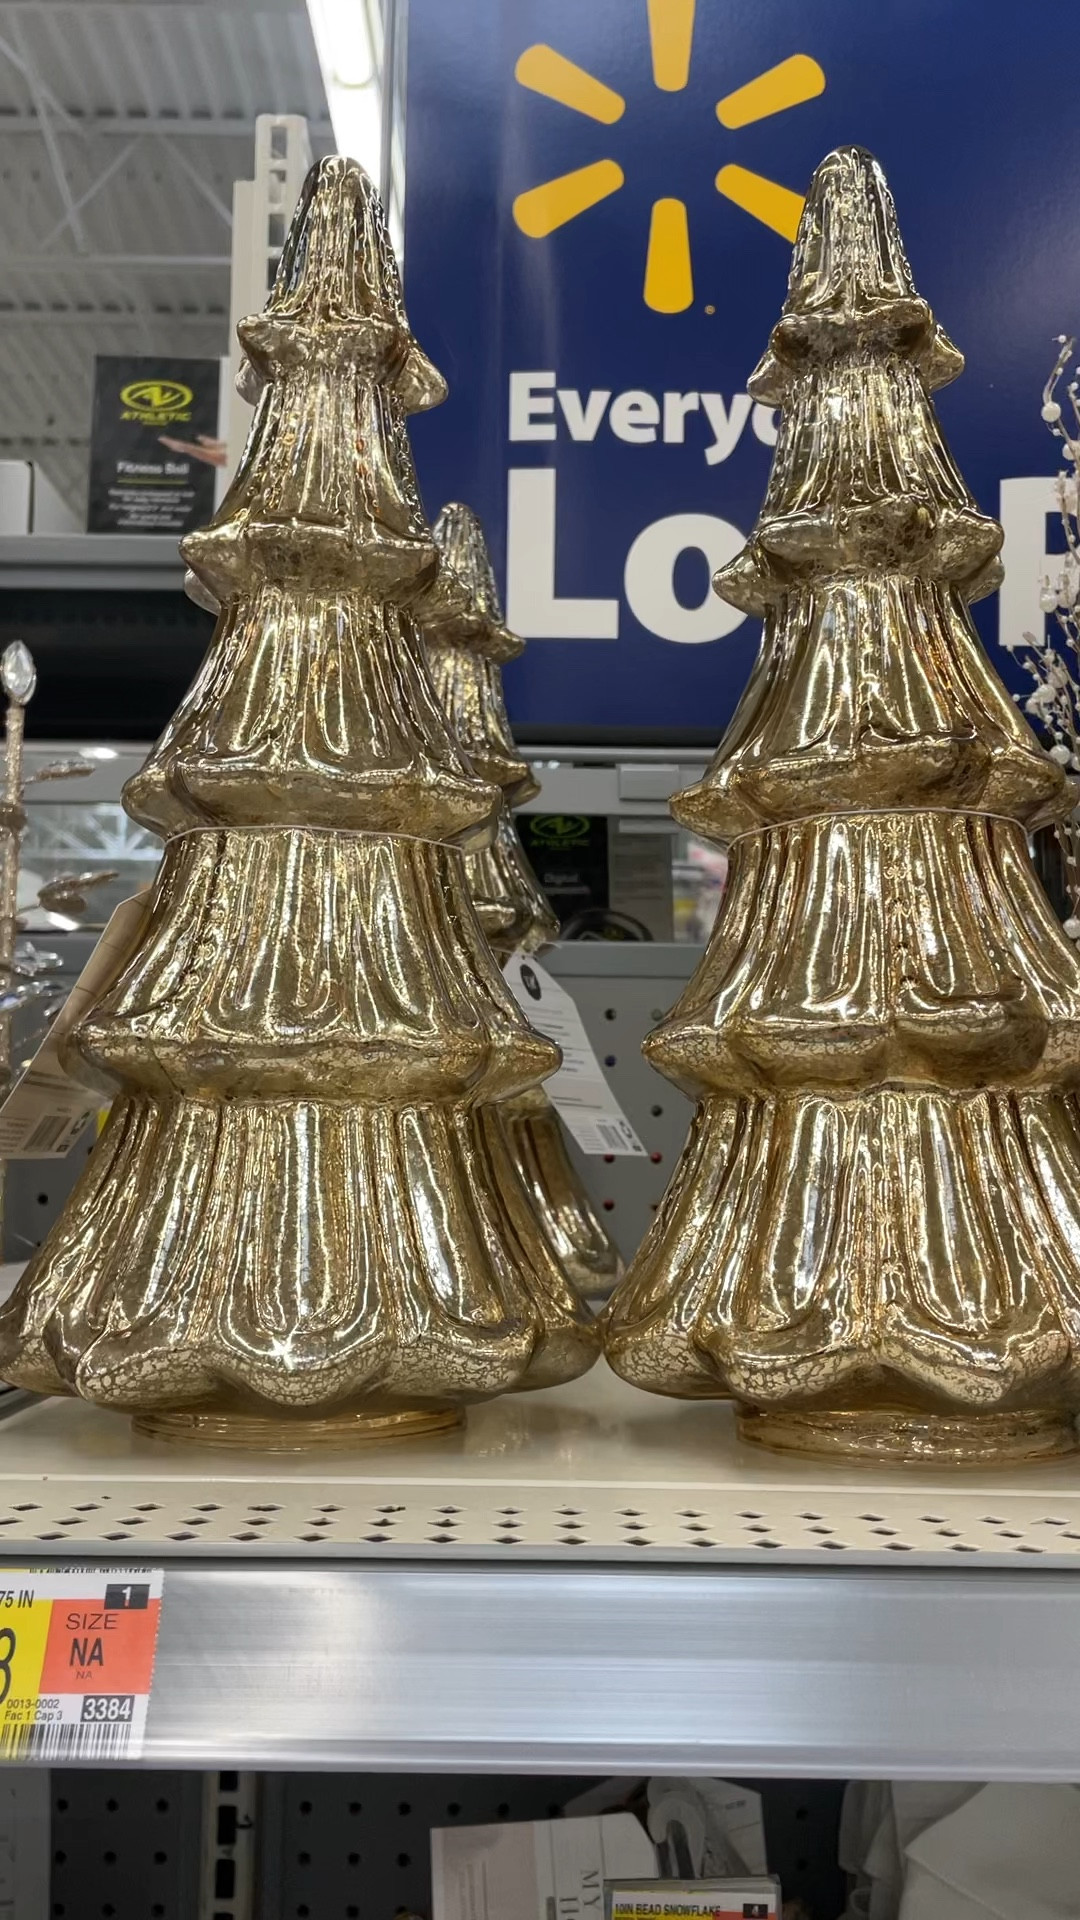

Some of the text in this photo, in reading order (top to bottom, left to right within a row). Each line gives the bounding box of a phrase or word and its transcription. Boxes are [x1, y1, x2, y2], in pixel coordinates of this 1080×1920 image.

[17, 1590, 35, 1609] IN
[121, 1585, 132, 1608] 1
[66, 1612, 119, 1630] SIZE
[69, 1637, 104, 1667] NA
[75, 1670, 93, 1680] NA
[6, 1698, 60, 1709] 0013-0002
[83, 1697, 132, 1721] 3384
[4, 1710, 63, 1722] Fac 1 Cap 3
[635, 1903, 662, 1916] BEAD
[663, 1903, 721, 1917] SNOWFLAKE
